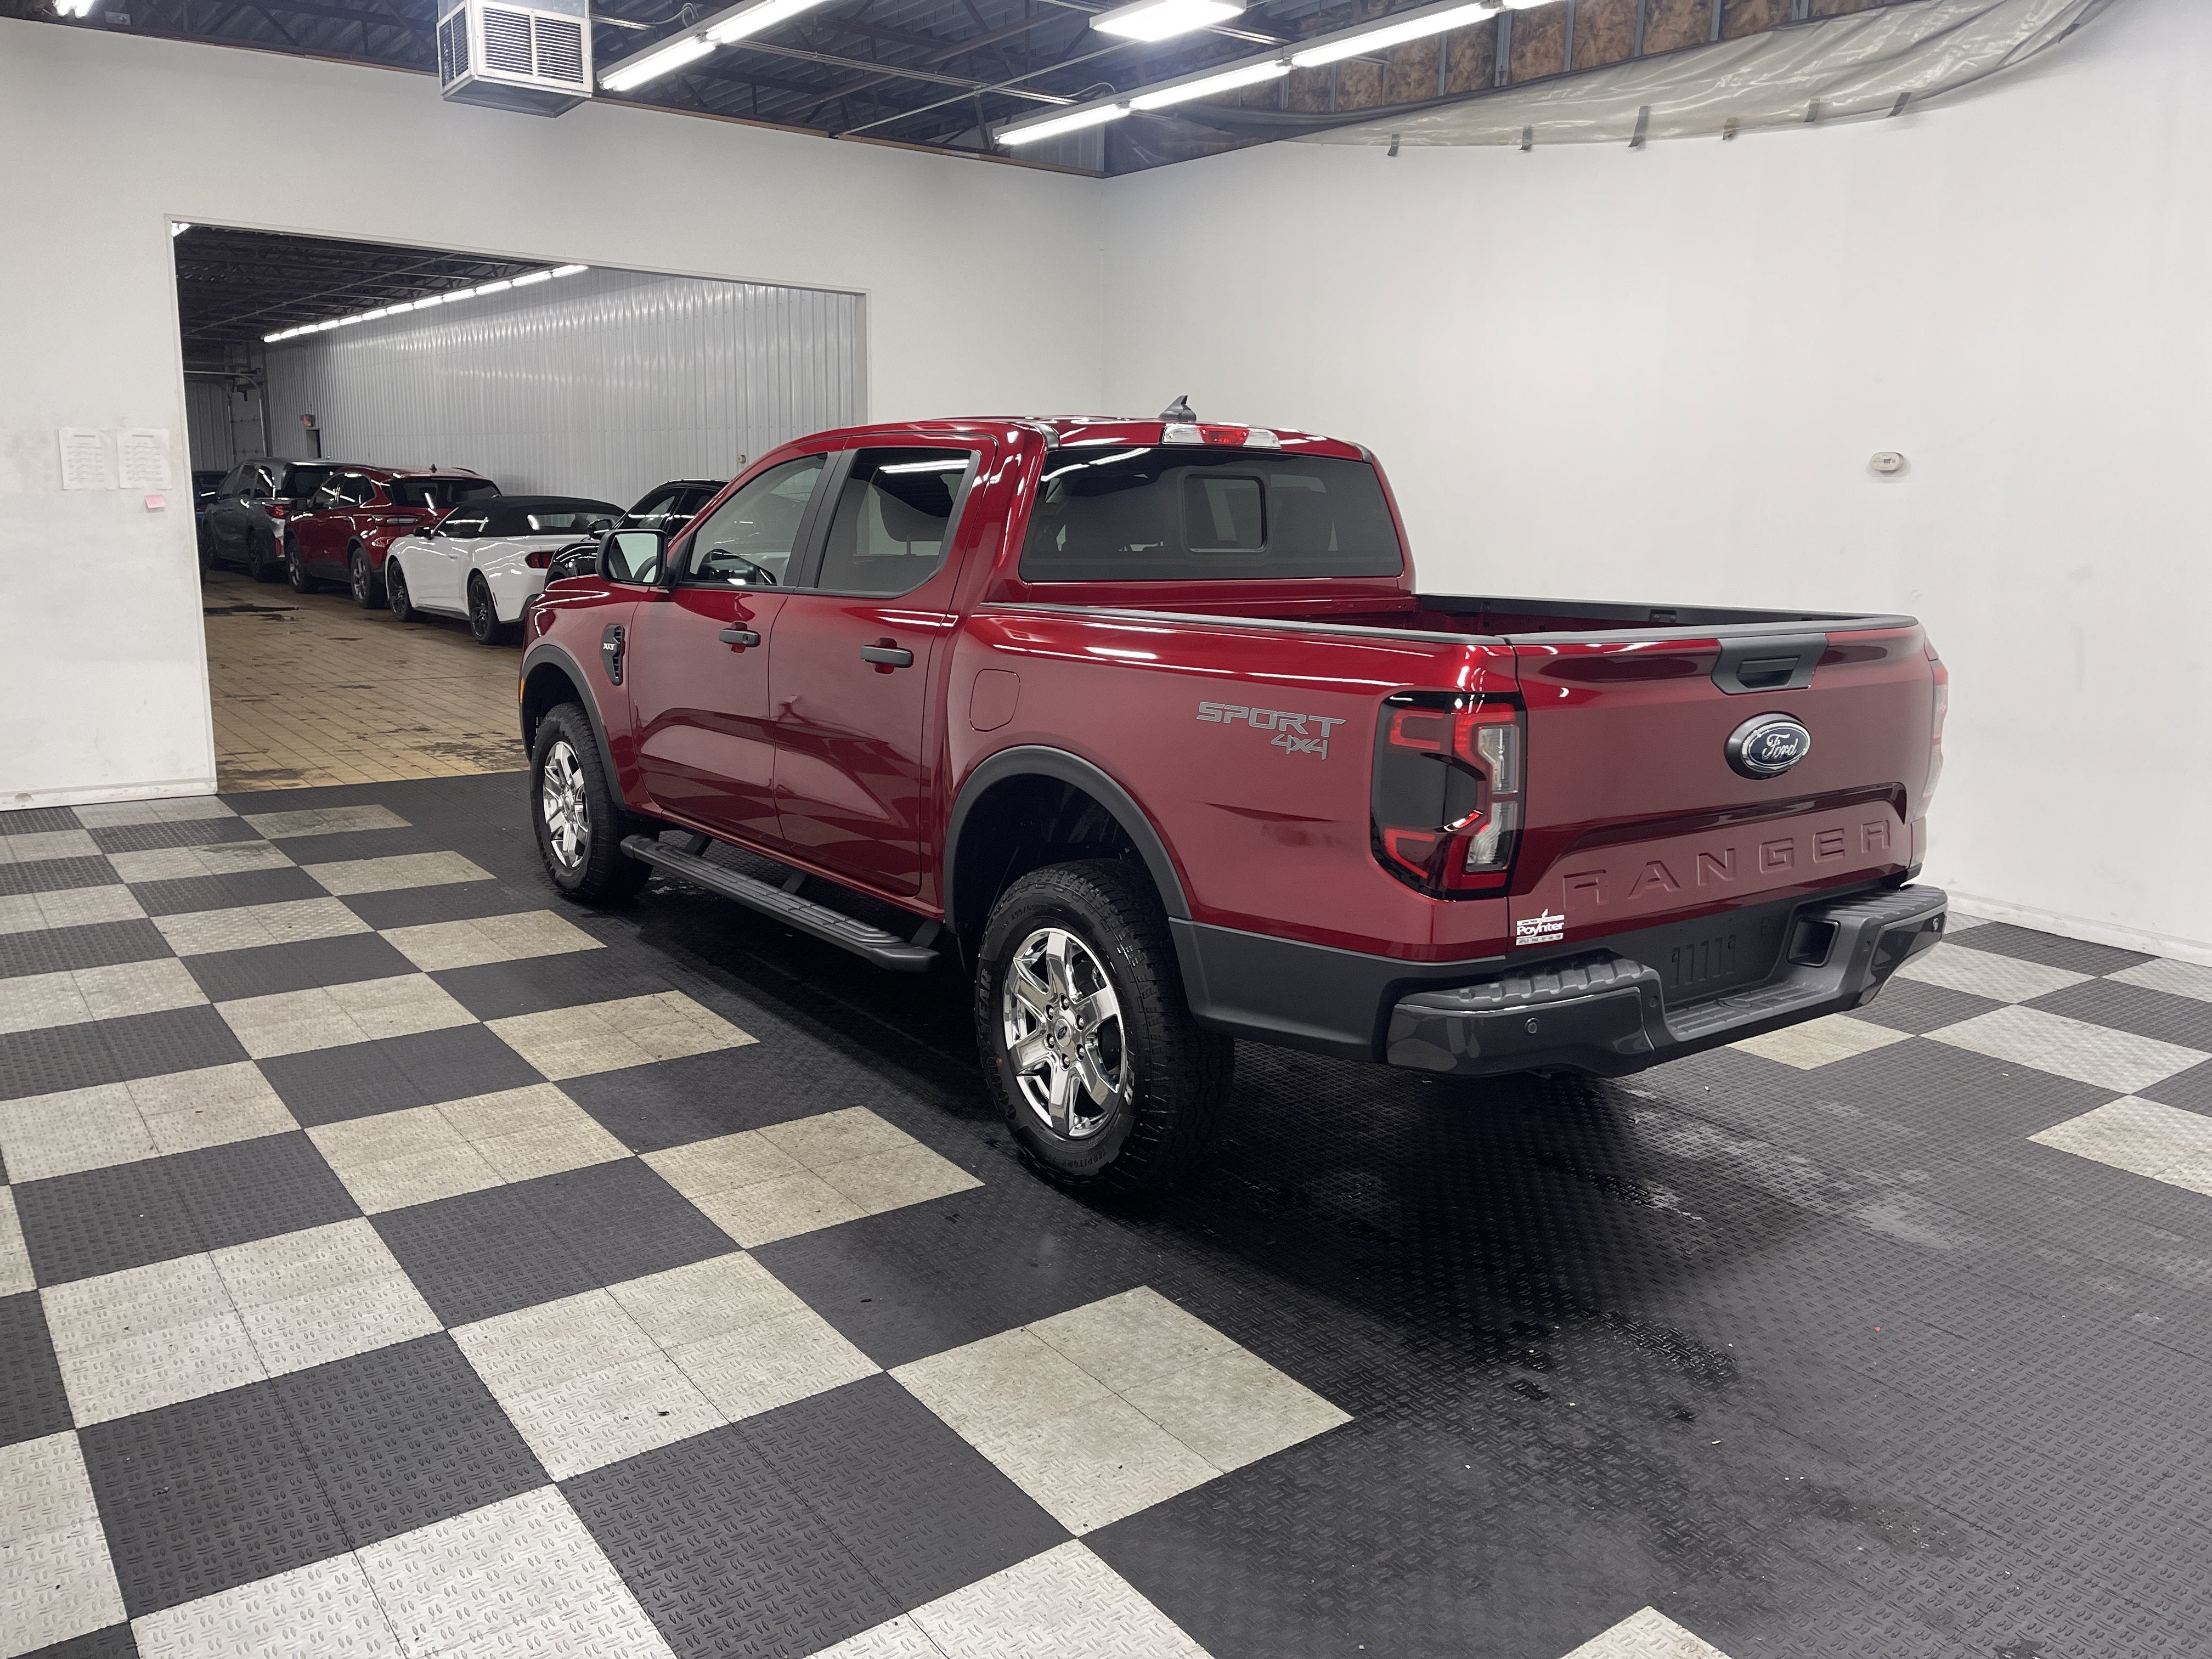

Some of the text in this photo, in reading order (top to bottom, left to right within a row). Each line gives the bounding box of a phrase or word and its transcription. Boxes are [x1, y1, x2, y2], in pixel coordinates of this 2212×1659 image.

[1196, 701, 1347, 737] SPORT
[1762, 733, 1799, 761] Ford
[1562, 819, 1891, 910] RANGER
[1516, 922, 1565, 938] Poynter
